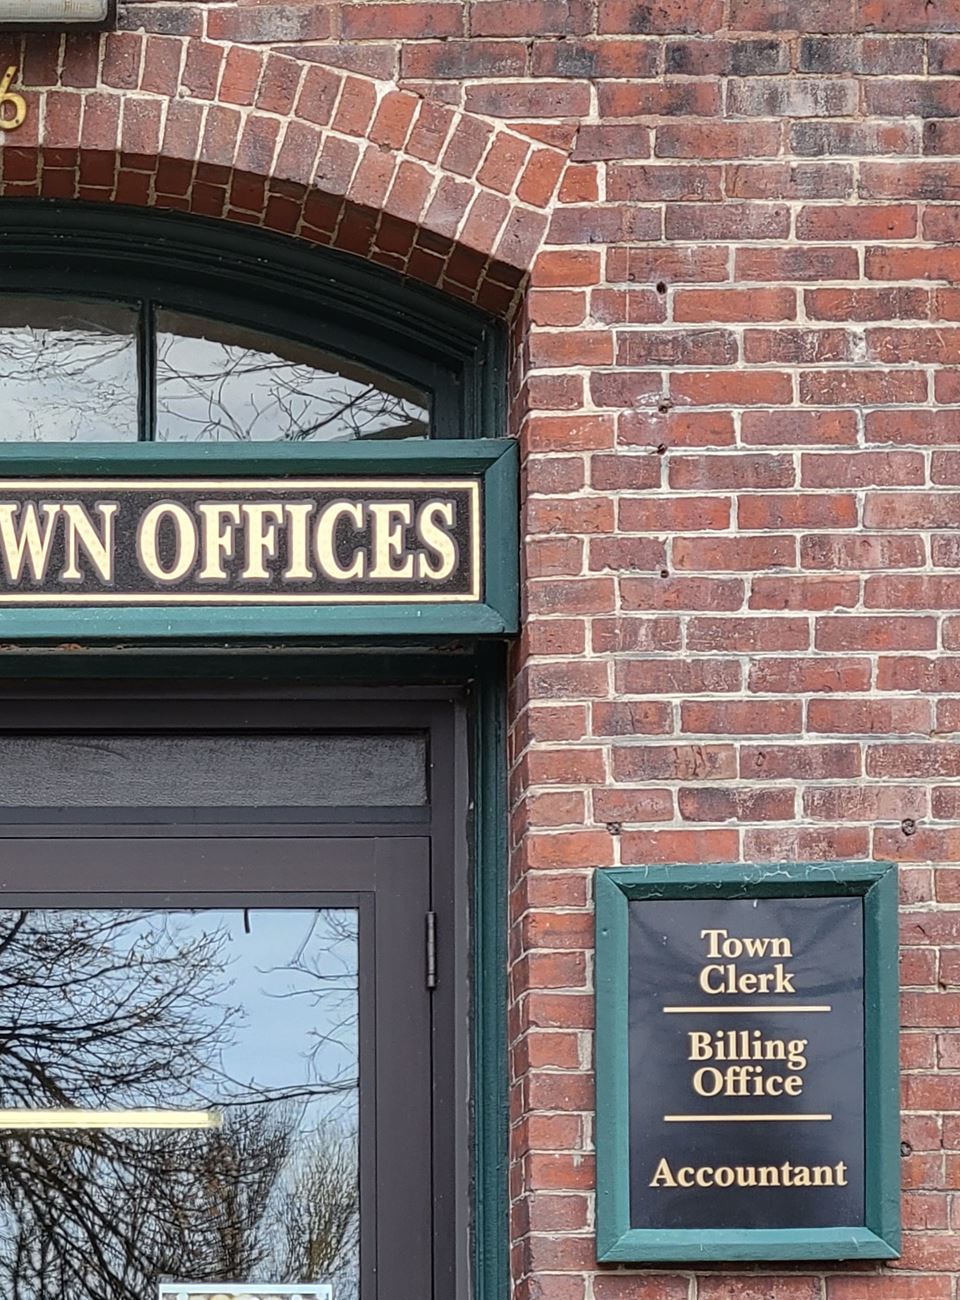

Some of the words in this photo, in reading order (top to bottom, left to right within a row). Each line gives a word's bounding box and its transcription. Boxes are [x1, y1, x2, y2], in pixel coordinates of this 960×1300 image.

[138, 501, 455, 582] OFFICES
[700, 929, 793, 959] Town
[699, 965, 796, 995] Clerk
[688, 1030, 808, 1070] Billing
[693, 1066, 803, 1097] Office
[649, 1158, 848, 1188] Accountant
